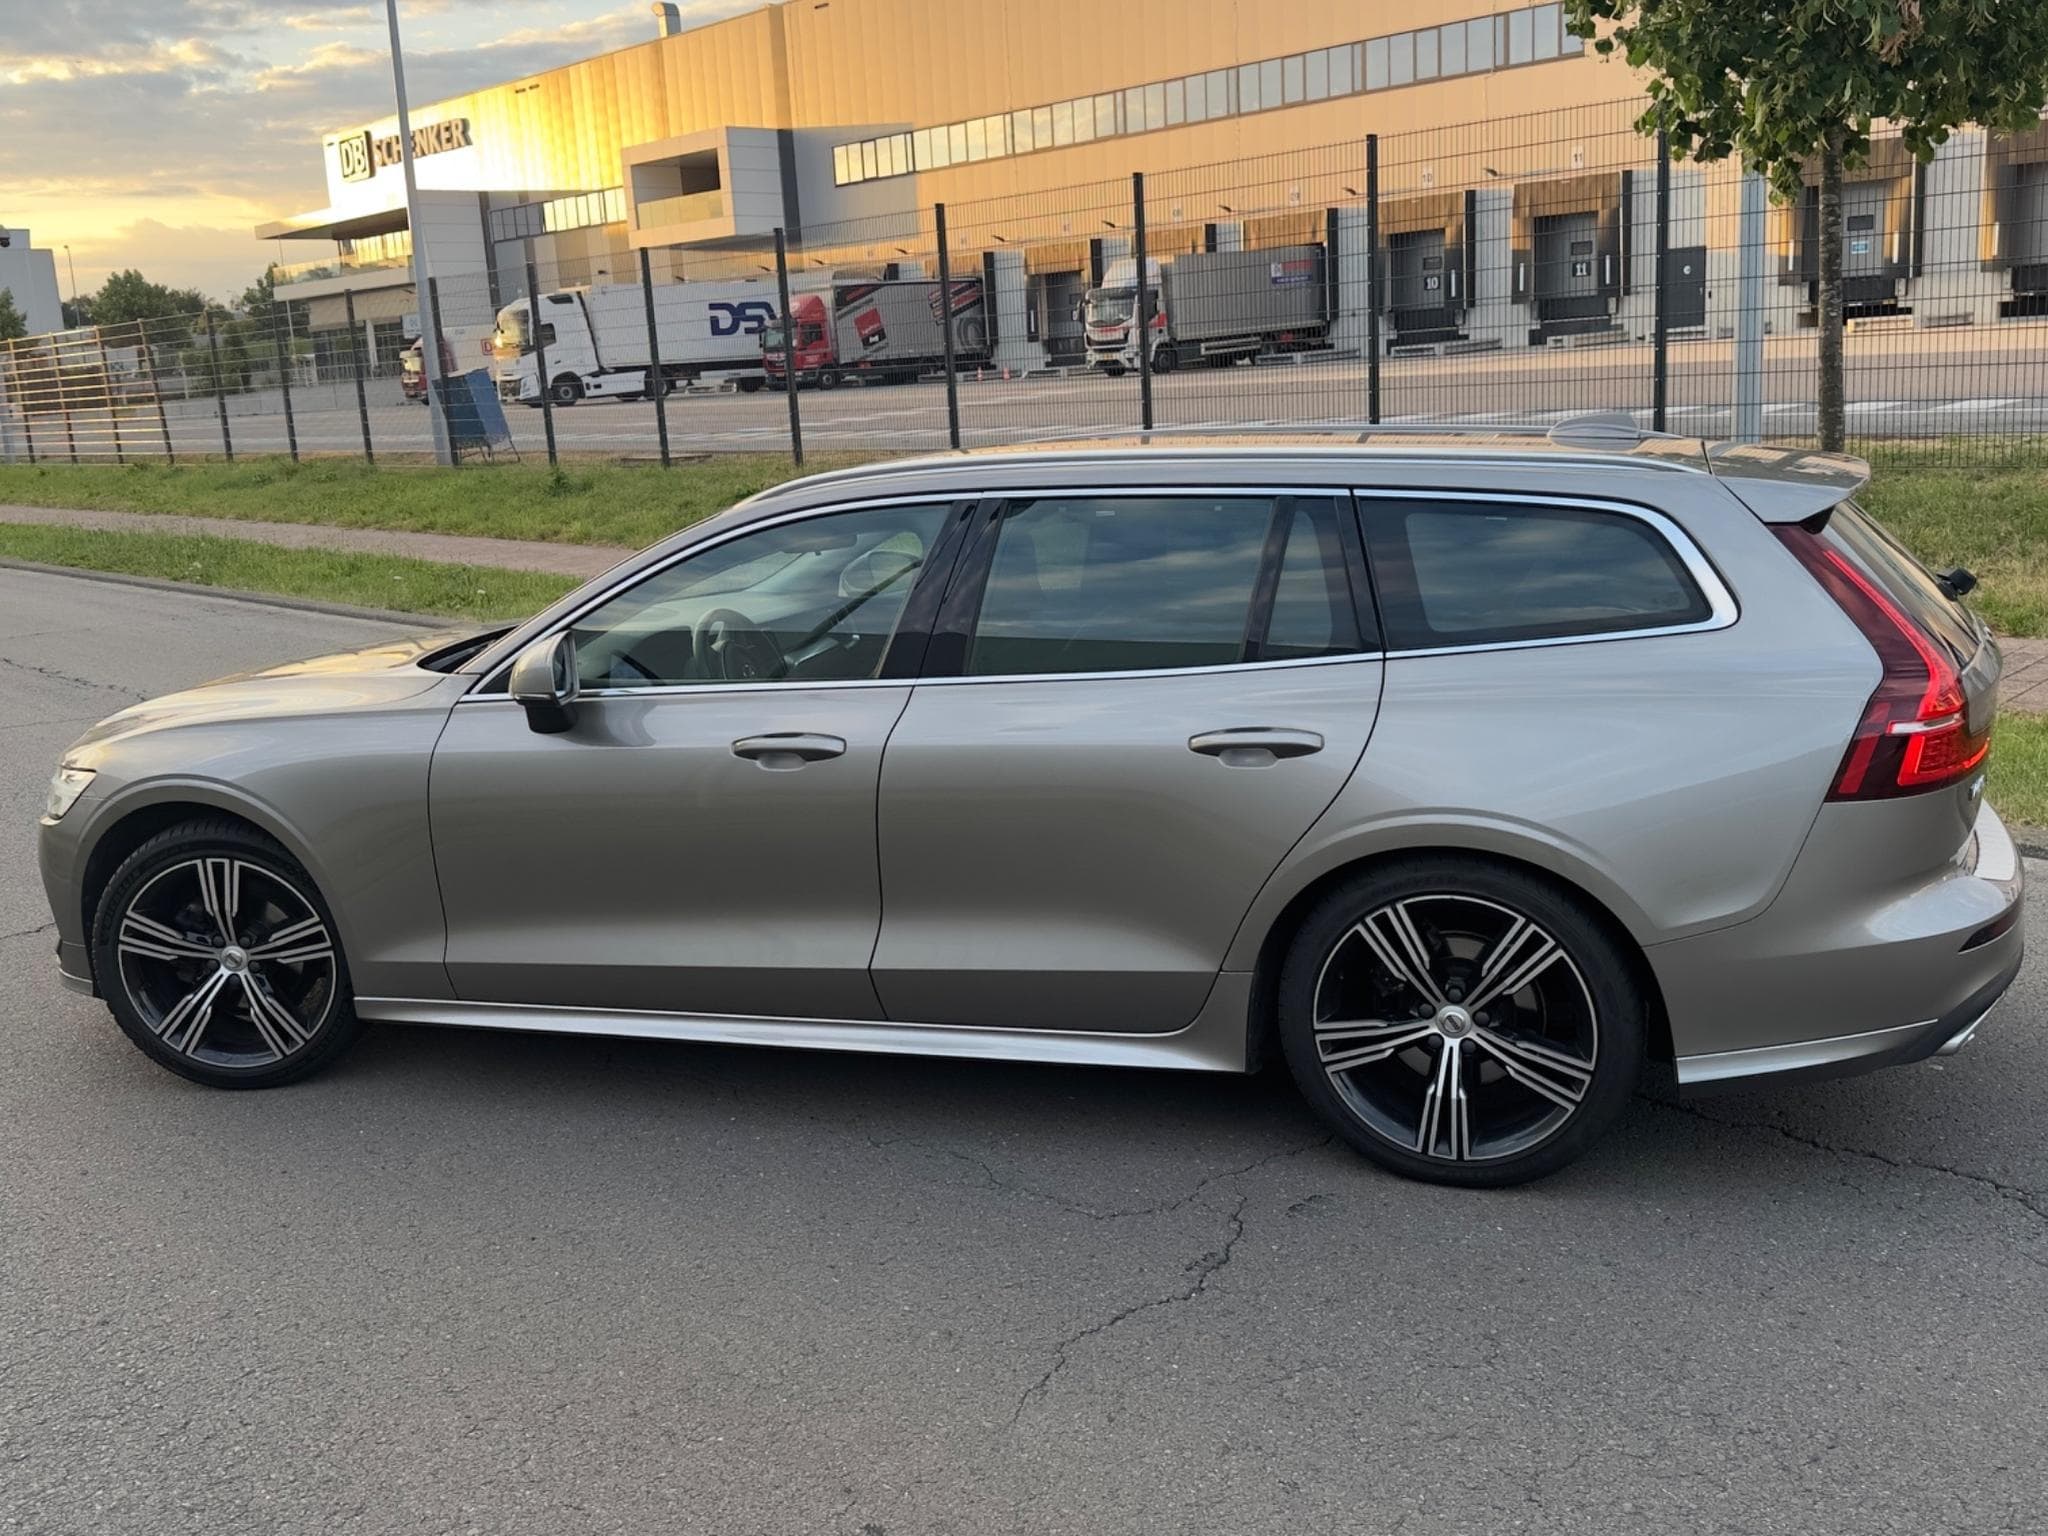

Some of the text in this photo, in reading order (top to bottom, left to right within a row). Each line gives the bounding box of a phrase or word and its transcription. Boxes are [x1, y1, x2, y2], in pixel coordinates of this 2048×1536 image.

[341, 136, 369, 178] DB
[1575, 262, 1587, 276] 11
[1426, 276, 1439, 290] 10
